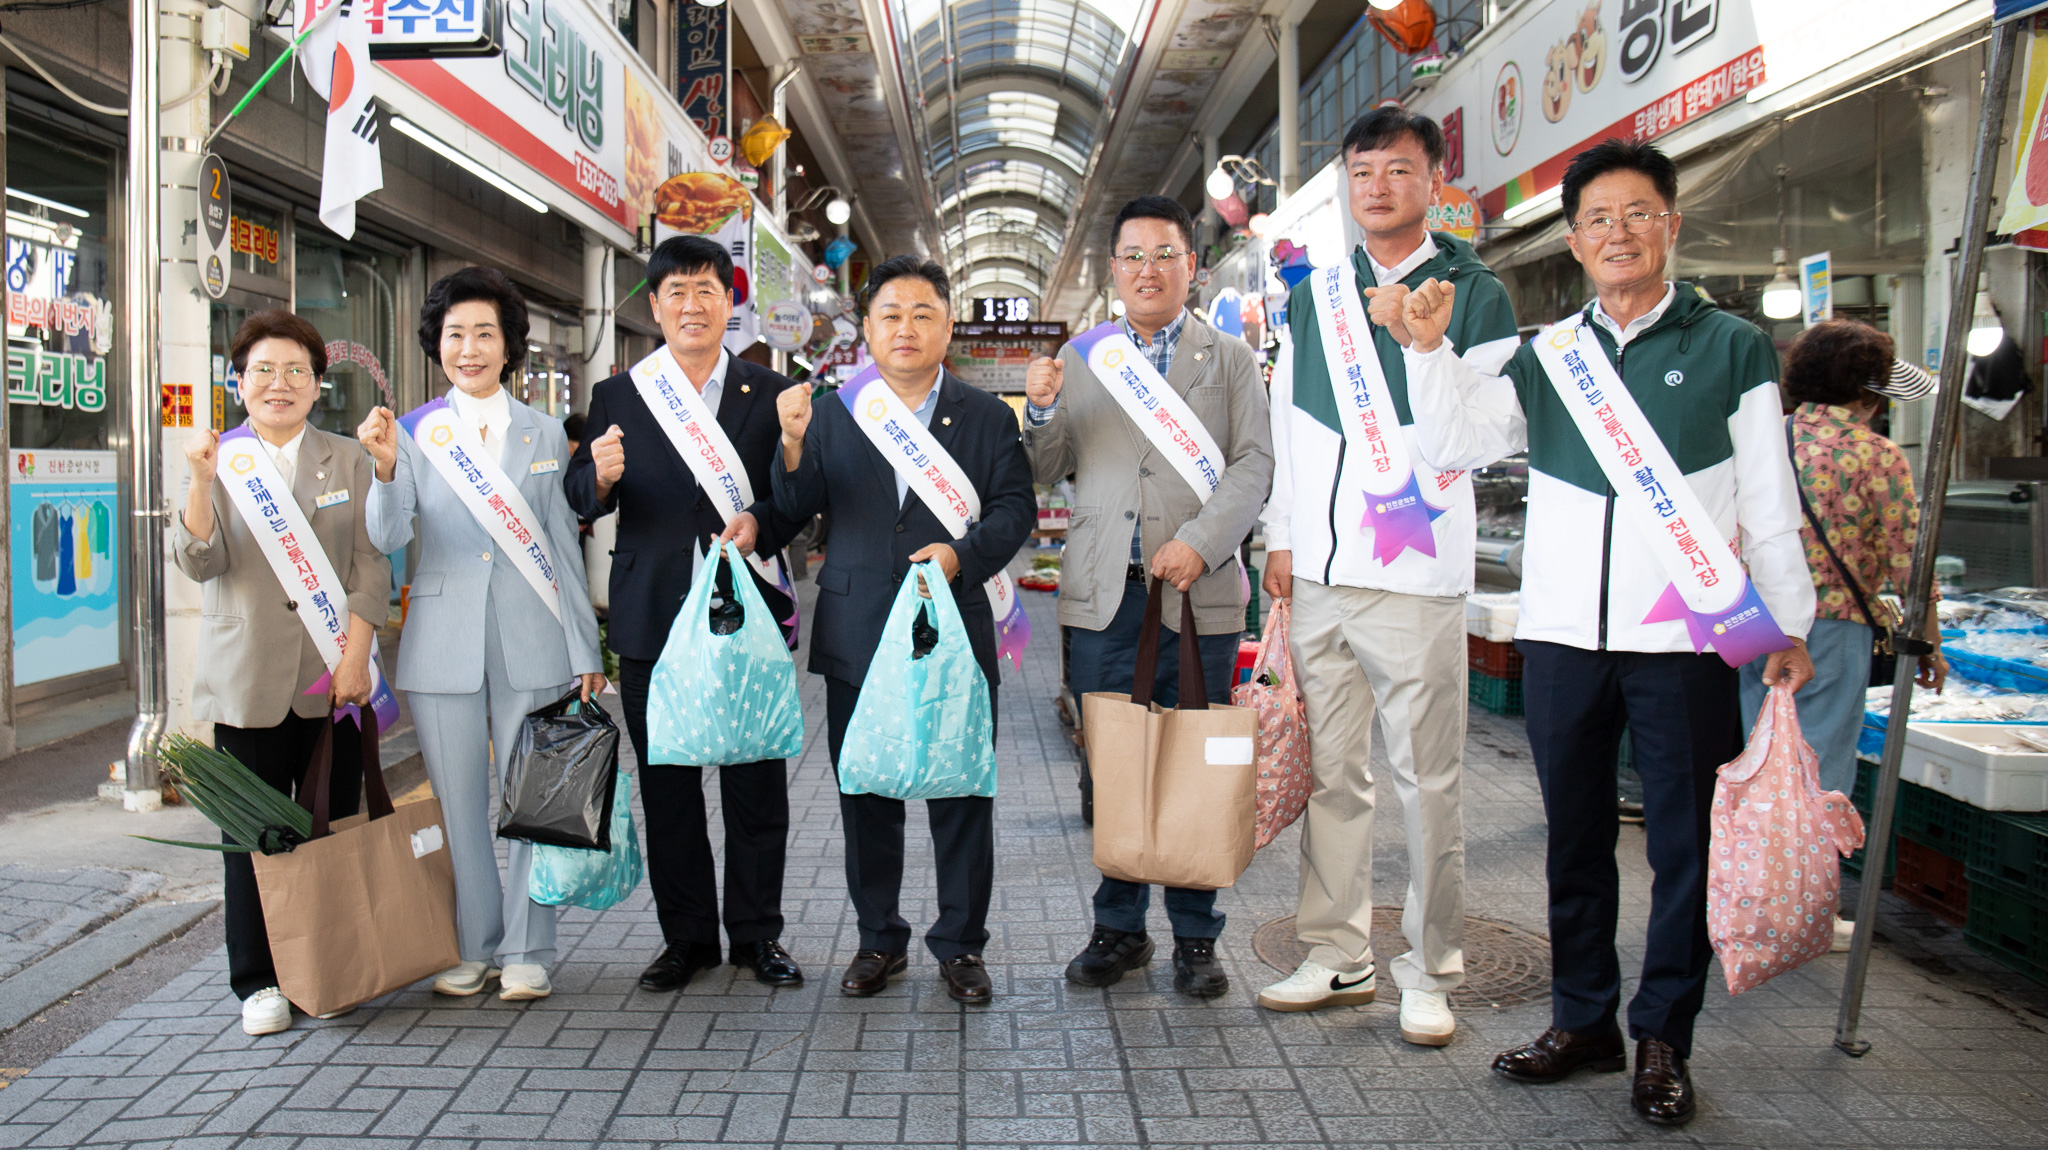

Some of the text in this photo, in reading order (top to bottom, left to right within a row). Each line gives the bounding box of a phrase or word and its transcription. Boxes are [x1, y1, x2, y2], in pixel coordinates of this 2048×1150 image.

[210, 168, 221, 200] 2
[713, 143, 729, 155] 22
[983, 297, 1029, 321] 1:18
[7, 349, 107, 413] 크리닝
[1120, 366, 1159, 410] 실천하는
[1154, 407, 1201, 458] 물가안정
[1326, 264, 1391, 473] 함께하는 전통시장 활기찬 전통시장
[655, 374, 692, 423] 실천하는
[684, 421, 727, 473] 물가안정
[883, 418, 930, 468] 함께하는
[924, 464, 970, 518] 전통시장
[1561, 349, 1720, 588] 함께하는 전통시장 활기찬 전통시장
[245, 476, 288, 534] 함께하는
[278, 532, 320, 592] 전통시장
[311, 591, 341, 634] 활기찬
[449, 445, 555, 582] 실천하는 물가안정 건강한
